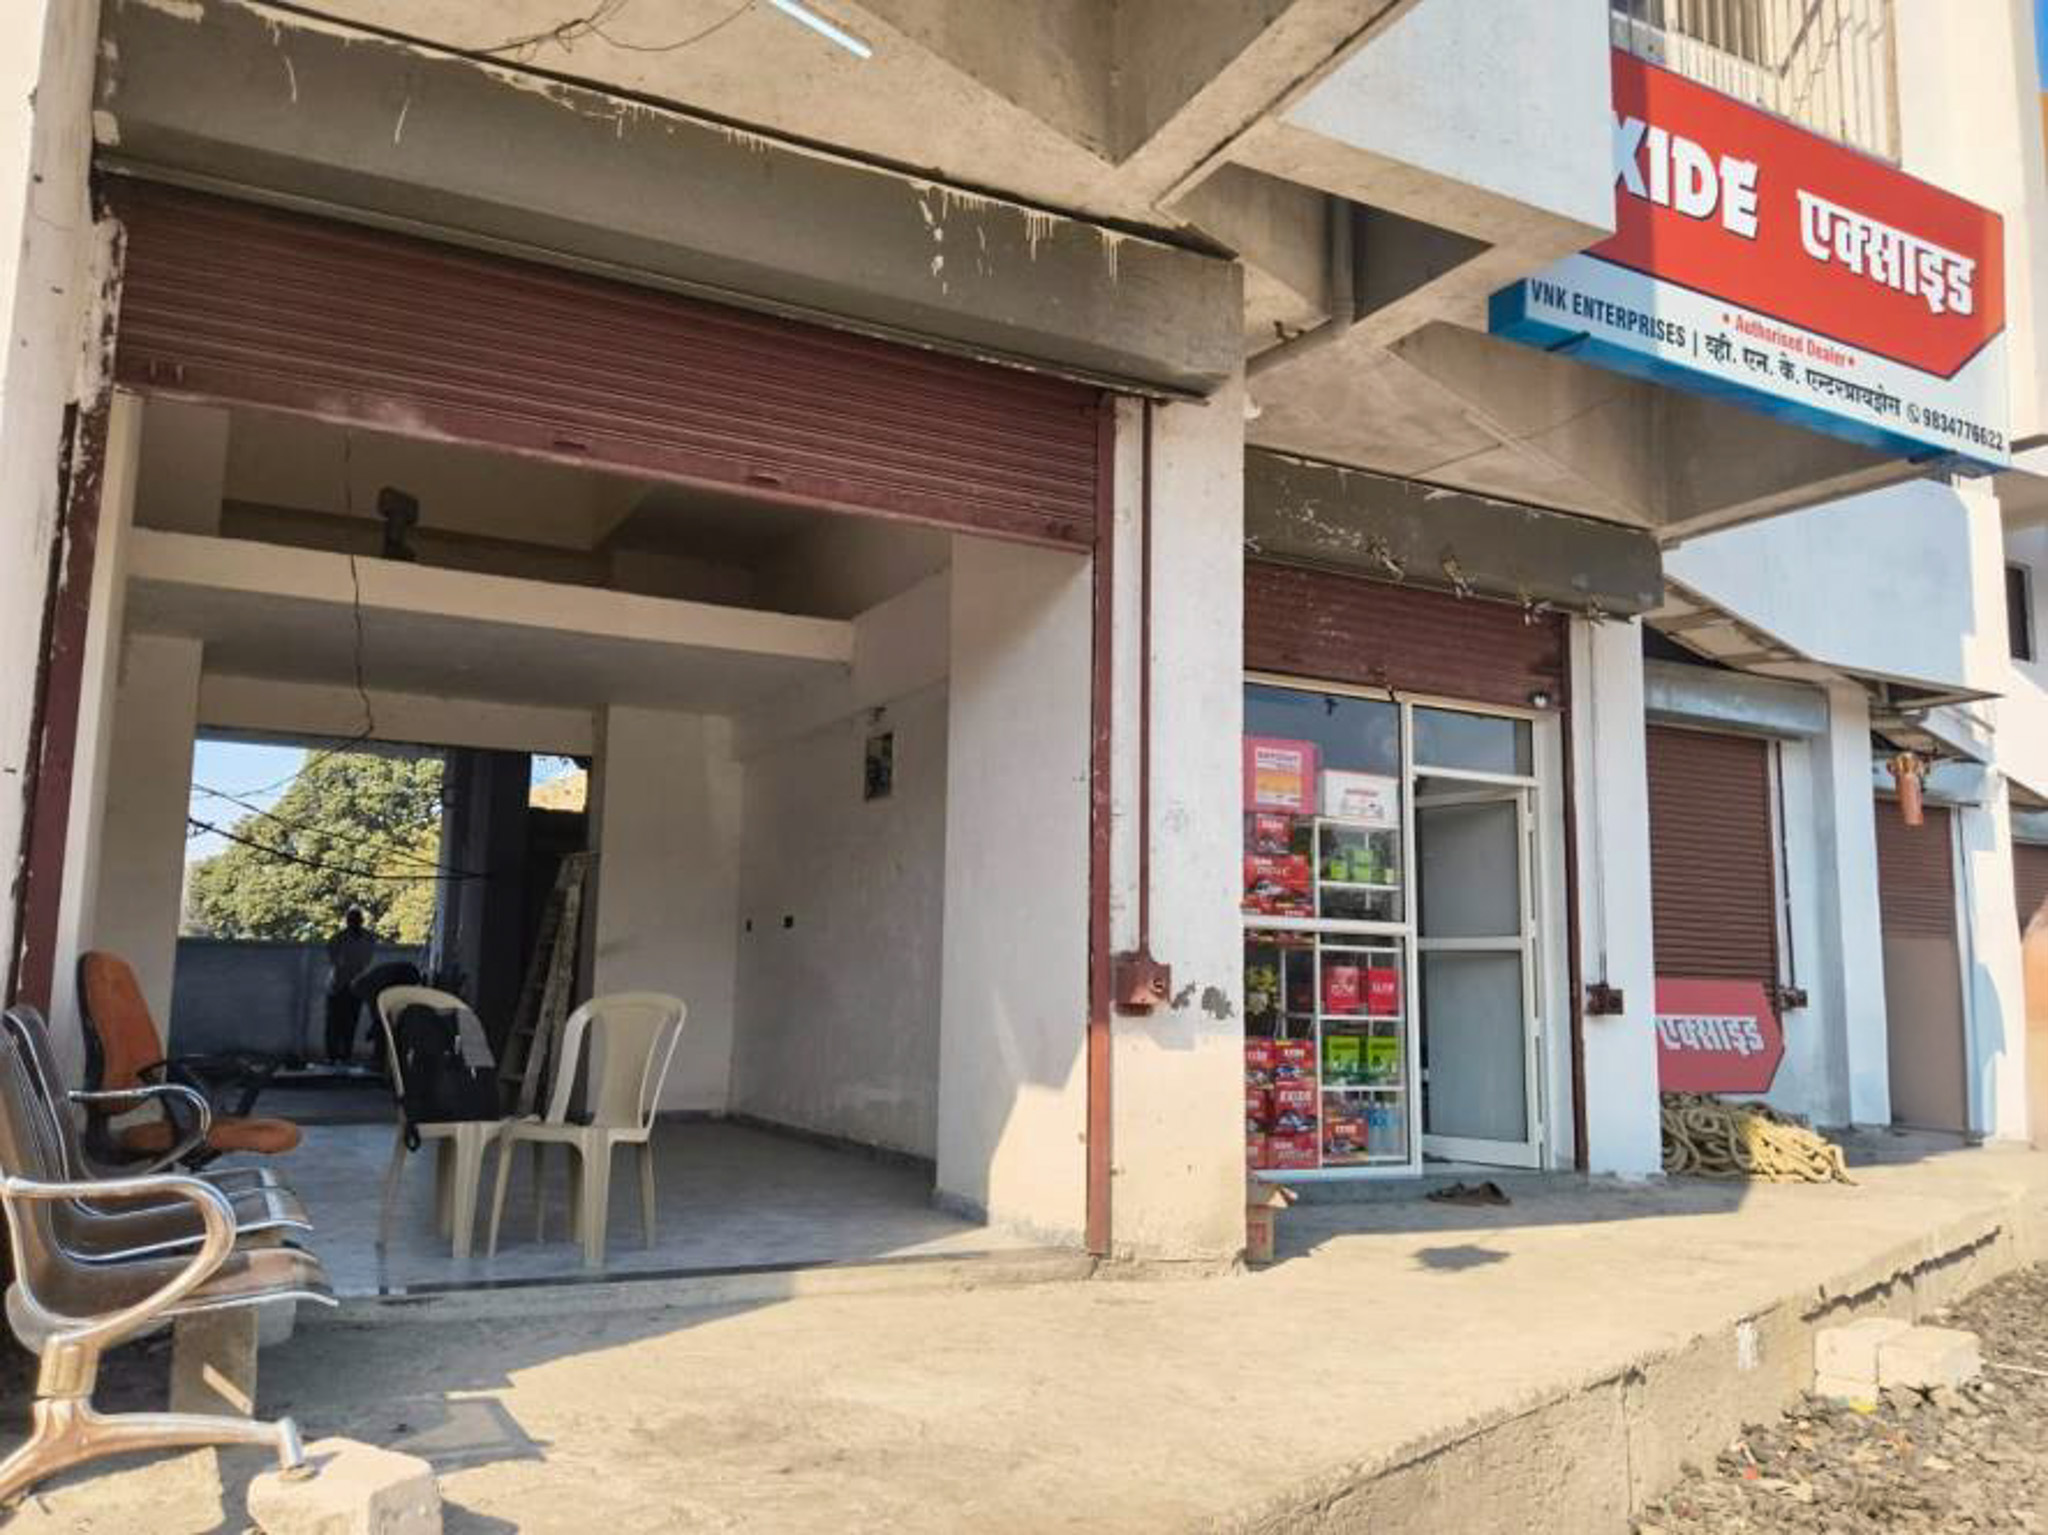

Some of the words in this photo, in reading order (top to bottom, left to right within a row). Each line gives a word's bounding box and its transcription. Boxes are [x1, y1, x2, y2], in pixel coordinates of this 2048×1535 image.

[1796, 187, 1977, 315] एक्साइड
[1531, 278, 1567, 312] VNK
[1572, 292, 1687, 348] ENTERPRISES
[1736, 314, 1804, 353] Authorised
[1806, 338, 1846, 367] Dealer
